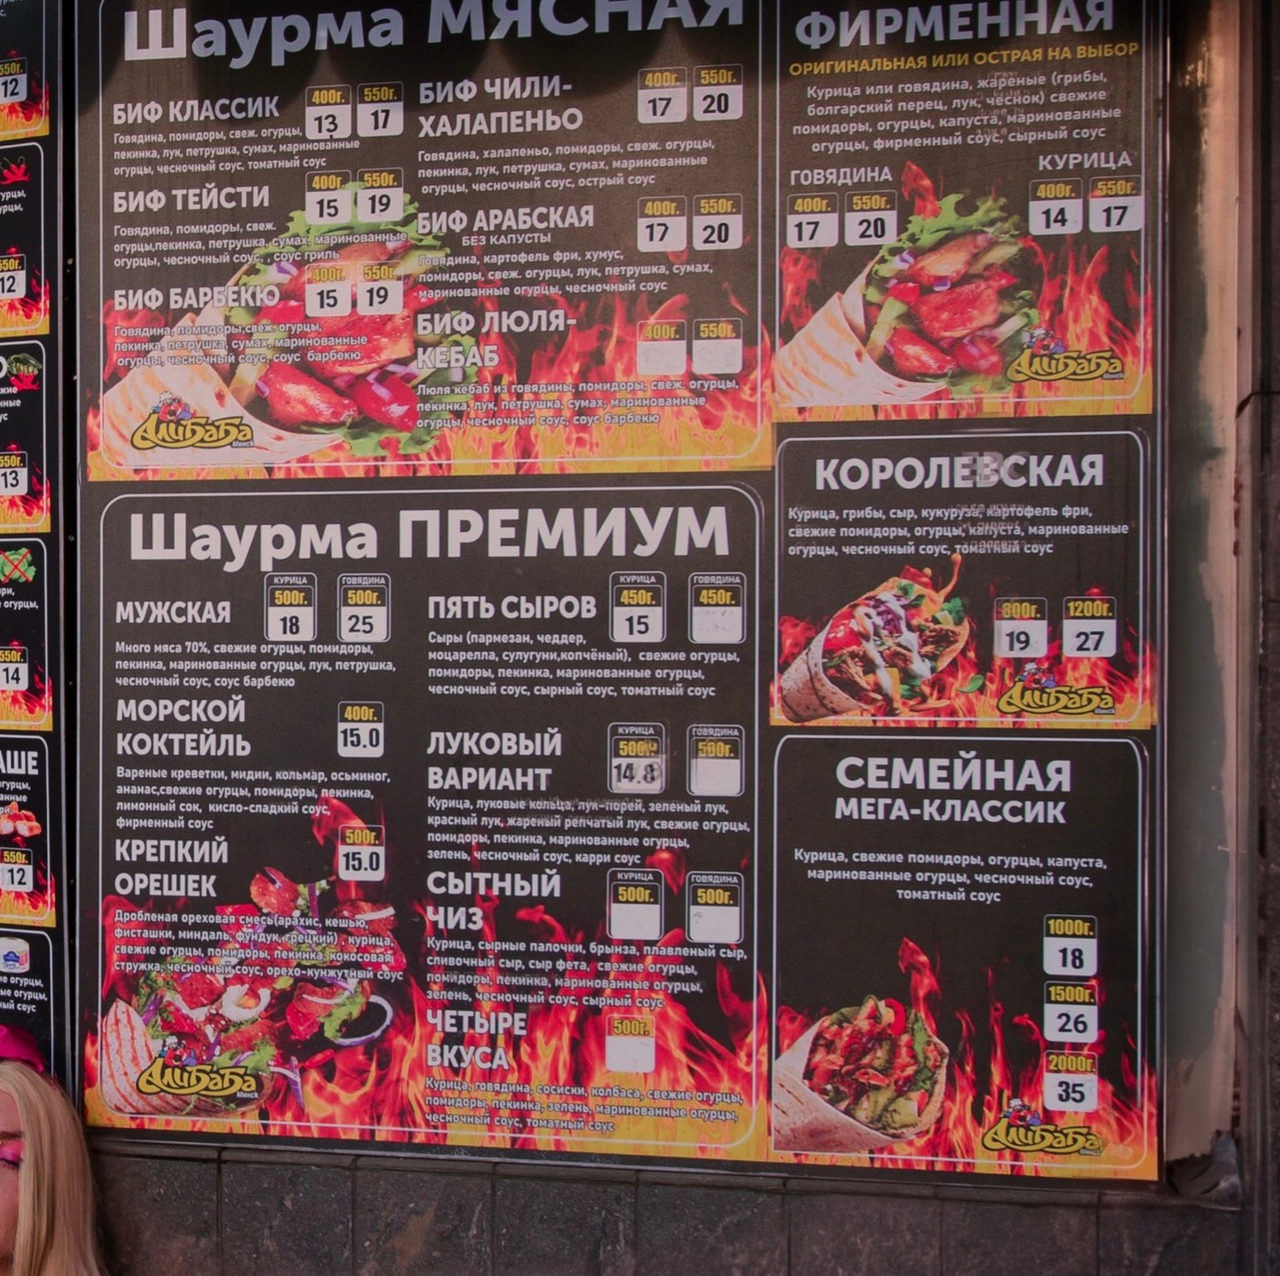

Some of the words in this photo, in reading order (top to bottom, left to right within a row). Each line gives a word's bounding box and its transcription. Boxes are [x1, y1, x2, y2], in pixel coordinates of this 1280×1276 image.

[123, 3, 404, 70] Шаурма
[789, 55, 927, 76] ОРИГИНАЛЬНАЯ
[932, 53, 968, 67] ИЛИ
[973, 47, 1043, 65] ОСТРАЯ
[1047, 46, 1072, 61] НА
[1076, 42, 1138, 59] ВЫБОР
[312, 89, 345, 104] 400г.
[364, 87, 397, 101] 550г.
[420, 79, 477, 103] БИФ
[484, 75, 572, 100] ЧИЛИ-
[807, 85, 861, 101] Курица
[865, 84, 893, 95] или
[897, 80, 973, 93] говядина,
[977, 75, 1046, 91] жареные
[1051, 69, 1107, 86] (грибы,
[112, 100, 163, 125] БИФ
[168, 96, 279, 122] КЛАССИК
[314, 113, 338, 134] 13
[370, 109, 390, 131] 17
[418, 107, 583, 138] ХАЛАПЕНЬО
[113, 132, 166, 145] Говядина,
[168, 130, 226, 142] помидоры,
[228, 129, 258, 139] свеж.
[260, 127, 302, 139] огурцы,
[790, 165, 893, 187] ГОВЯДИНА
[1038, 150, 1132, 172] КУРИЦА
[113, 189, 166, 213] БИФ
[171, 182, 269, 210] ТЕЙСТИ
[414, 209, 468, 237] БИФ
[472, 204, 594, 232] АРАБСКАЯ
[1041, 208, 1068, 229] 14
[1101, 205, 1128, 227] 17
[462, 235, 486, 248] БЕЗ
[490, 232, 551, 245] КАПУСТЫ
[794, 221, 820, 242] 17
[858, 218, 886, 239] 20
[110, 287, 163, 314] БИФ
[169, 279, 283, 310] БАРБЕКЮ
[417, 313, 475, 336] БИФ
[481, 309, 577, 333] ЛЮЛЯ-
[417, 346, 499, 370] КЕБАБ
[814, 453, 1105, 491] КОРОЛЕВСКАЯ
[130, 512, 377, 572] Шаурма
[398, 506, 730, 559] ПРЕМИУМ
[273, 576, 308, 585] КУРИЦА
[342, 576, 386, 585] ГОВЯДИНА
[116, 601, 231, 623] МУЖСКАЯ
[428, 595, 495, 618] ПЯТЬ
[501, 595, 597, 619] СЫРОВ
[280, 615, 300, 635] 18
[348, 615, 374, 634] 25
[625, 615, 650, 636] 15
[115, 641, 151, 653] Много
[154, 643, 182, 653] мяса
[184, 641, 210, 654] 70%,
[213, 644, 257, 653] свежие
[260, 640, 306, 656] огурцы,
[309, 643, 374, 656] помидоры,
[2, 667, 21, 684] 14
[115, 673, 180, 686] чесночный
[182, 677, 211, 689] соус,
[214, 677, 240, 689] соус
[243, 675, 295, 689] барбекю
[116, 694, 246, 722] МОРСКОЙ
[116, 728, 251, 756] КОКТЕЙЛЬ
[340, 728, 380, 748] 15.0
[427, 727, 562, 756] ЛУКОВЫЙ
[428, 766, 552, 791] ВАРИАНТ
[835, 750, 1071, 792] СЕМЕЙНАЯ
[835, 797, 1066, 823] МЕГА-КЛАССИК
[115, 835, 228, 865] КРЕПКИЙ
[794, 848, 848, 863] Курица,
[852, 852, 904, 863] свежие
[908, 853, 984, 867] помидоры,
[988, 855, 1043, 869] огурцы,
[1047, 857, 1107, 870] капуста,
[114, 873, 217, 899] ОРЕШЕК
[426, 867, 561, 899] СЫТНЫЙ
[896, 887, 965, 900] томатный
[969, 891, 1001, 904] соус
[426, 907, 484, 931] ЧИЗ
[1047, 918, 1094, 937] 1000г.
[1057, 946, 1084, 971] 18
[425, 1009, 527, 1036] ЧЕТЫРЕ
[1056, 1011, 1088, 1035] 26
[426, 1044, 509, 1071] ВКУСА
[1056, 1080, 1086, 1103] 35
